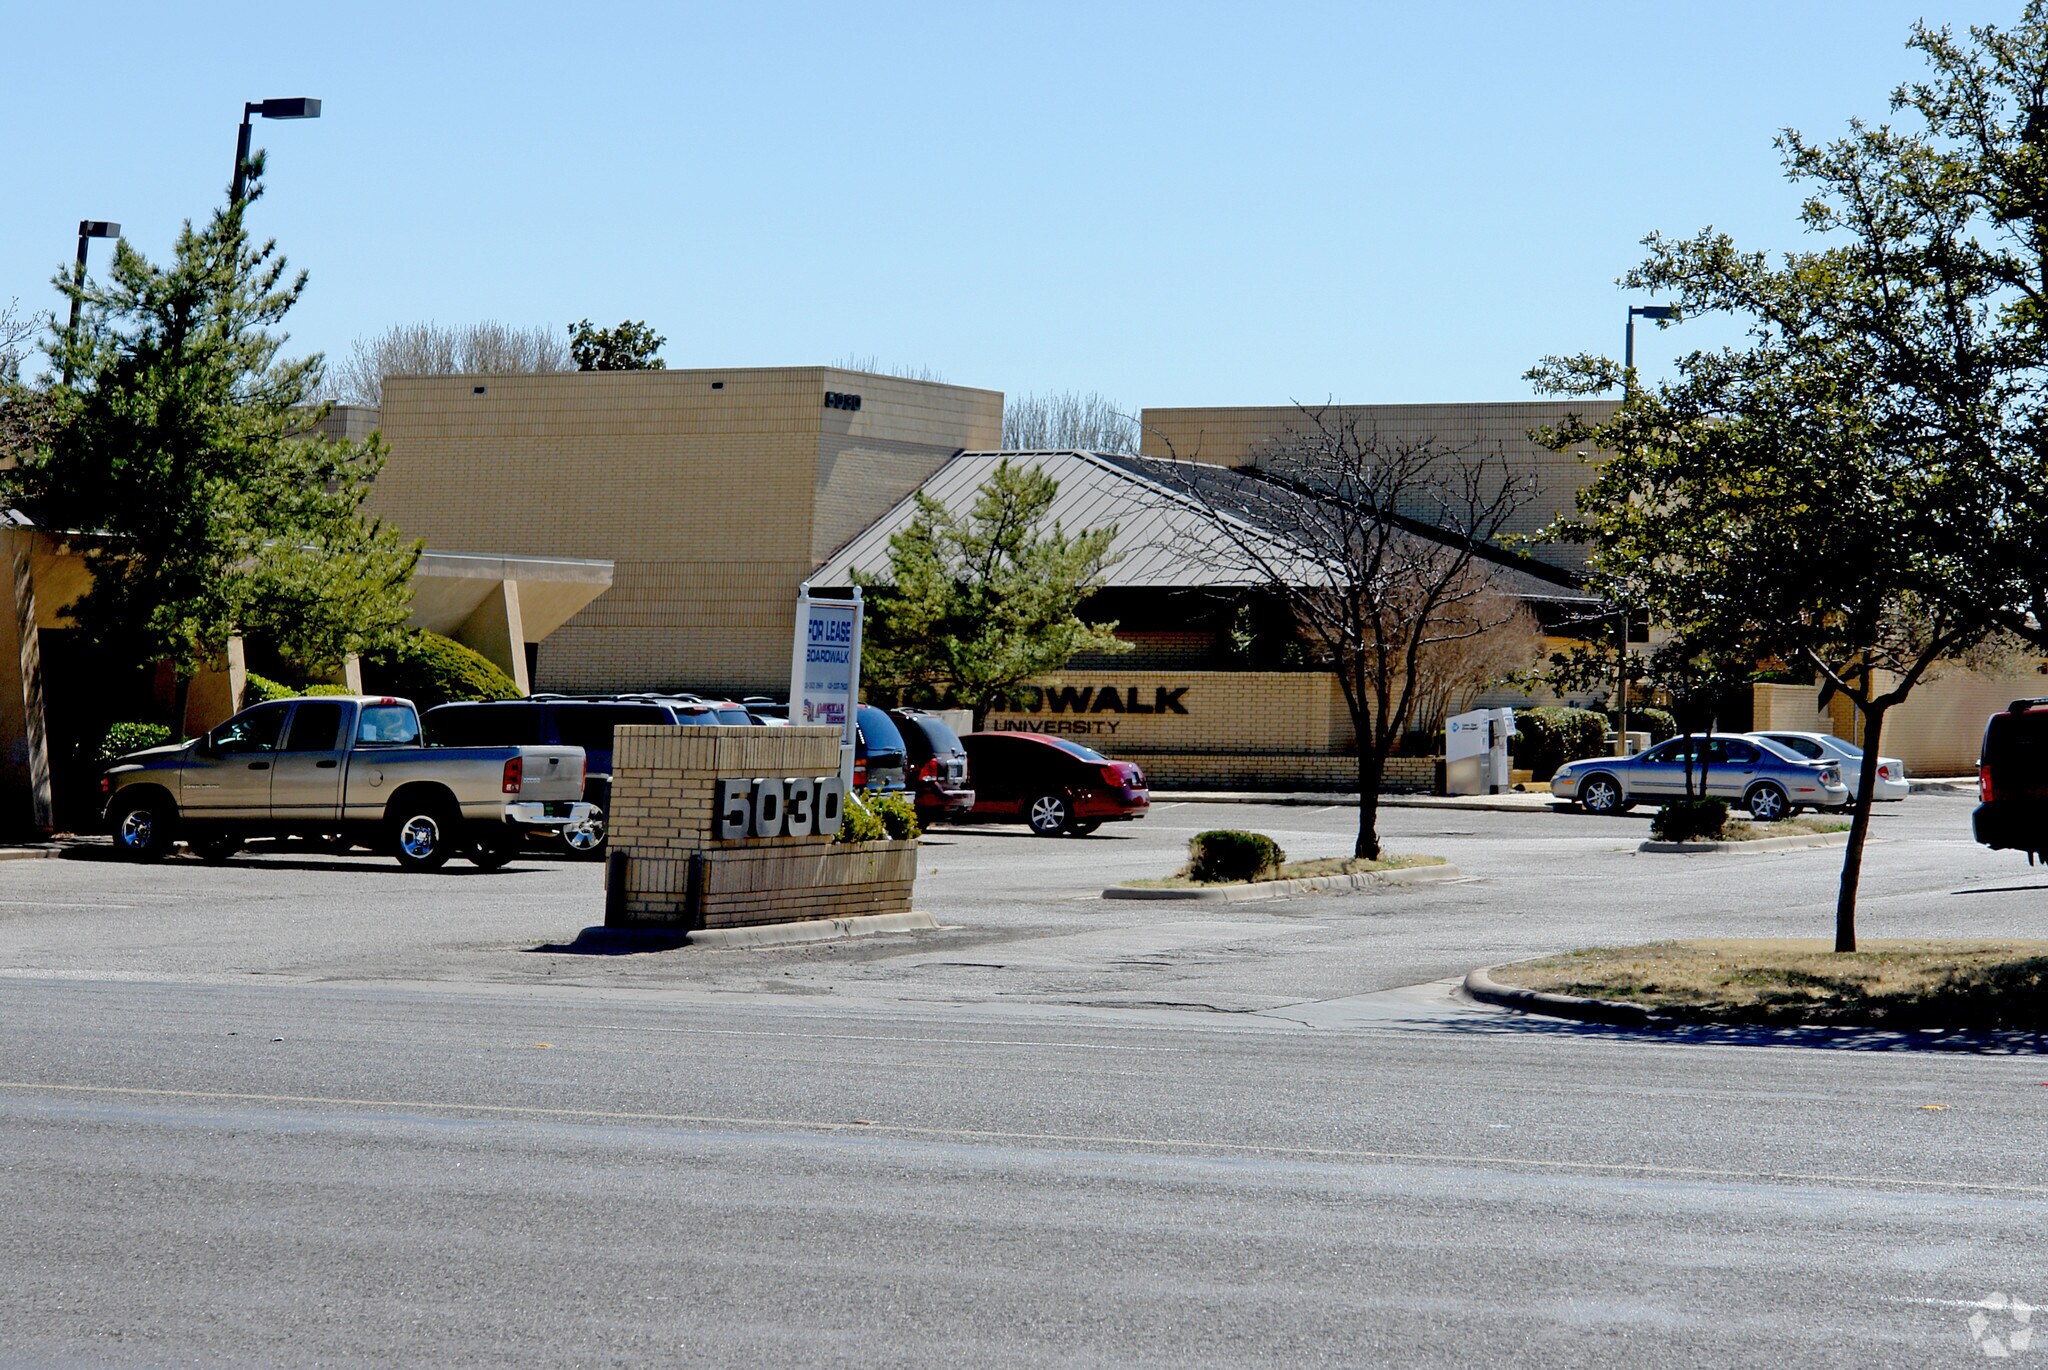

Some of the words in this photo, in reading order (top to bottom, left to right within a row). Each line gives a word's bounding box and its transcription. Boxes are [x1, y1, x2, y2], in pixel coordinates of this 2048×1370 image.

[824, 391, 862, 411] 5030
[808, 619, 824, 641] FOR
[825, 620, 851, 642] LEASE
[806, 649, 850, 664] BOARDWALK
[993, 719, 1120, 734] UNIVERSITY
[715, 777, 845, 839] 5030
